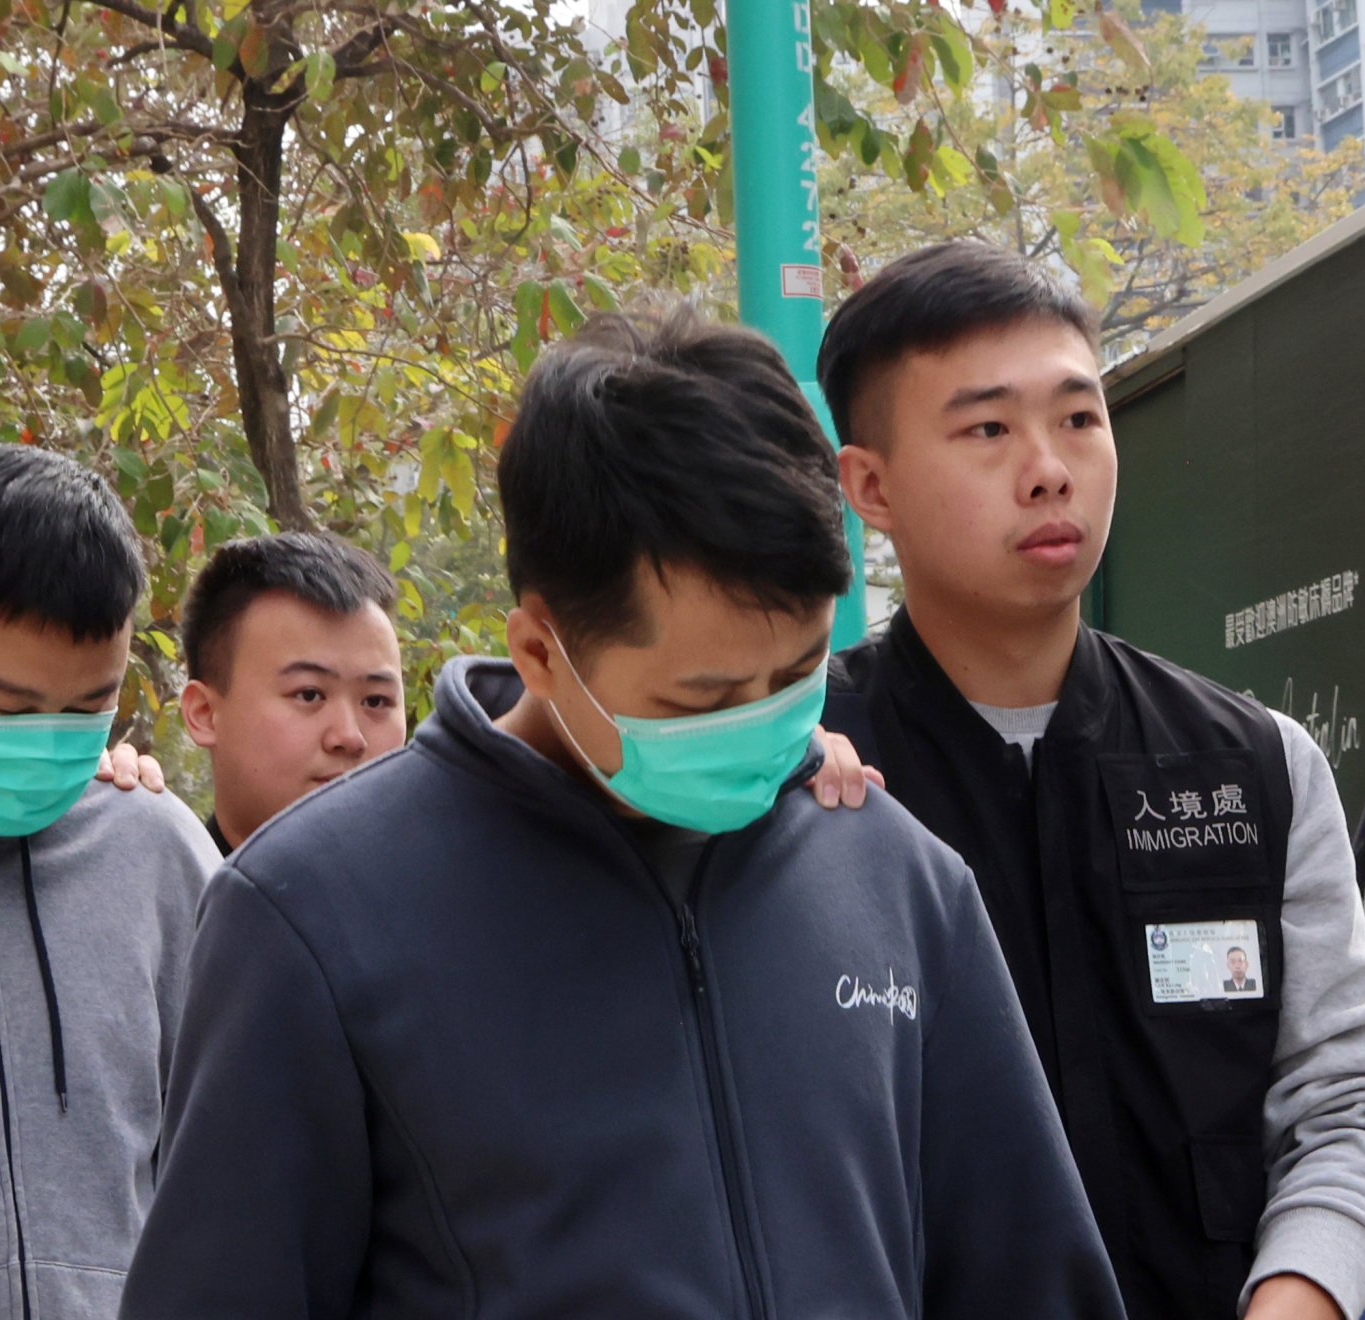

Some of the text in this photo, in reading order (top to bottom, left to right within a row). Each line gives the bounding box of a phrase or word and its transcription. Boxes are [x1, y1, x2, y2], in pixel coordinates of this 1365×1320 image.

[1135, 784, 1247, 820] 入境處
[1126, 822, 1258, 852] IMMIGRATION
